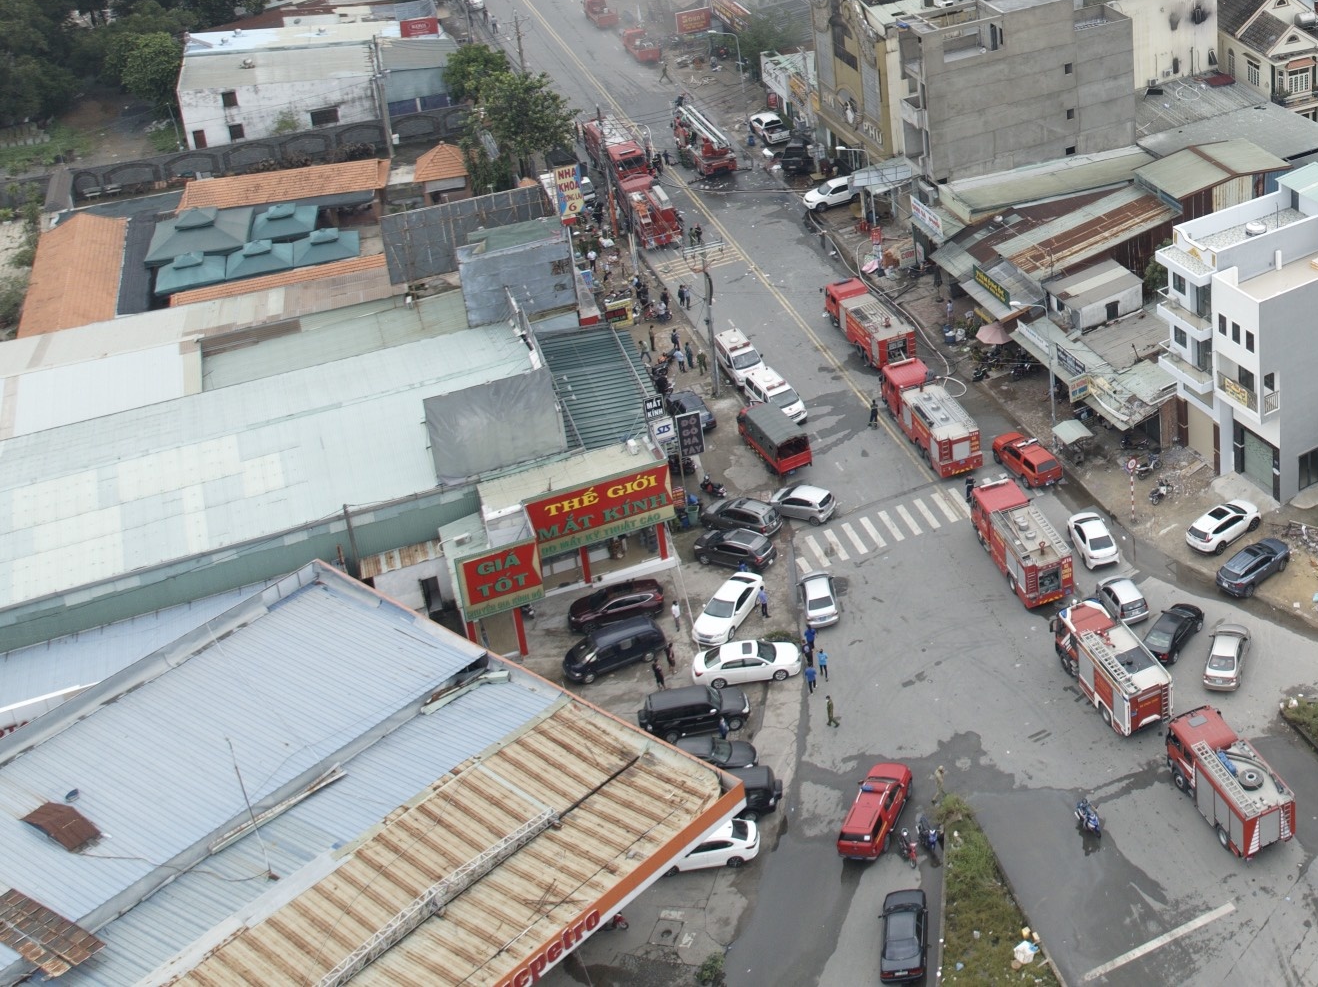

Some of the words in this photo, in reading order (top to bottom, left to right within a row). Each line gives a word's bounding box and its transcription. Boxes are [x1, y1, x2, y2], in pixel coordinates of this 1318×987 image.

[558, 167, 576, 180] NHA
[558, 180, 580, 193] KHOA
[569, 202, 577, 211] 6
[647, 408, 664, 418] KÍNH
[544, 486, 600, 517] THẾ
[606, 474, 658, 498] GIỚI
[538, 513, 594, 541] MẮT
[602, 492, 668, 523] KÍNH
[640, 512, 661, 525] CAO
[477, 552, 520, 575] GIÁ
[477, 572, 528, 597] TỐT
